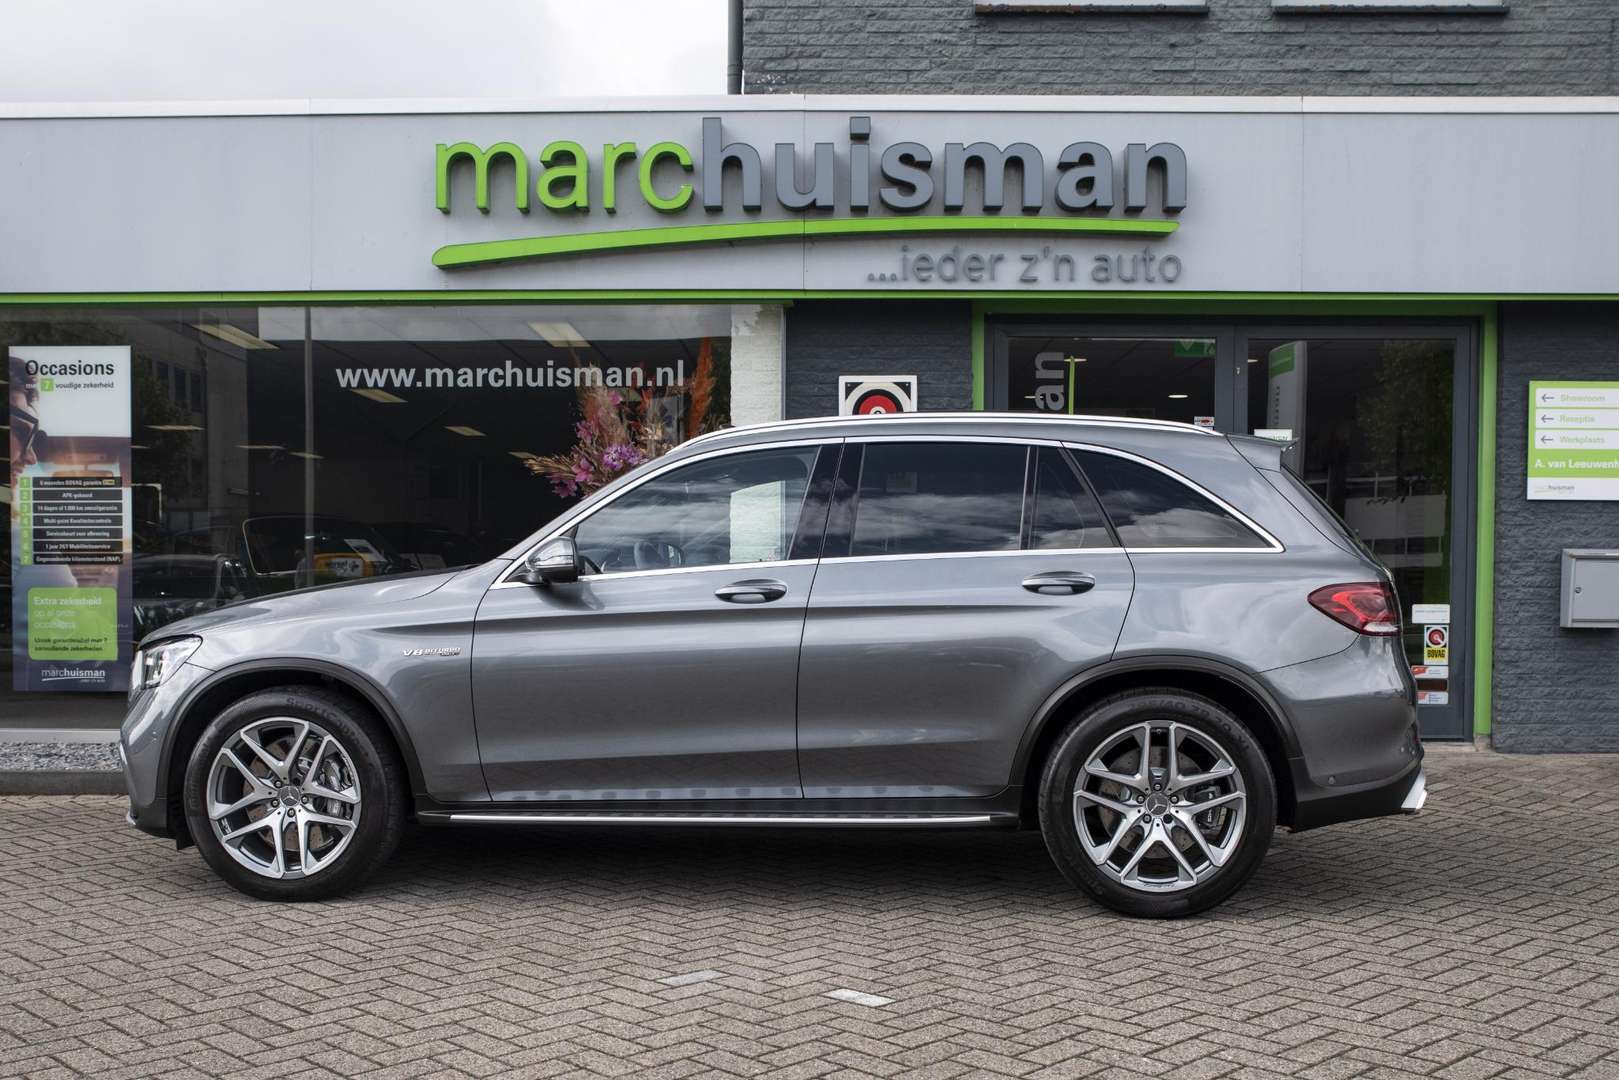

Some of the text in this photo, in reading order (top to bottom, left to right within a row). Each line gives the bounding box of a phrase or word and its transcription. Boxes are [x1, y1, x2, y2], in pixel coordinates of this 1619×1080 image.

[435, 116, 1187, 214] marchuisman
[1019, 246, 1076, 283] z'n
[1091, 246, 1182, 283] auto
[25, 359, 115, 375] Occasions
[335, 360, 685, 388] www.marchuisman.nl
[55, 381, 81, 390] voudige
[82, 381, 114, 389] zekerheid
[1560, 393, 1606, 402] Showroom
[1560, 414, 1595, 424] Receptie
[1560, 434, 1605, 446] Werkplaats
[1535, 459, 1546, 469] A.
[1548, 460, 1567, 469] van
[402, 648, 423, 657] V8
[1427, 649, 1446, 659] BOVAG
[41, 667, 106, 677] marchuisman
